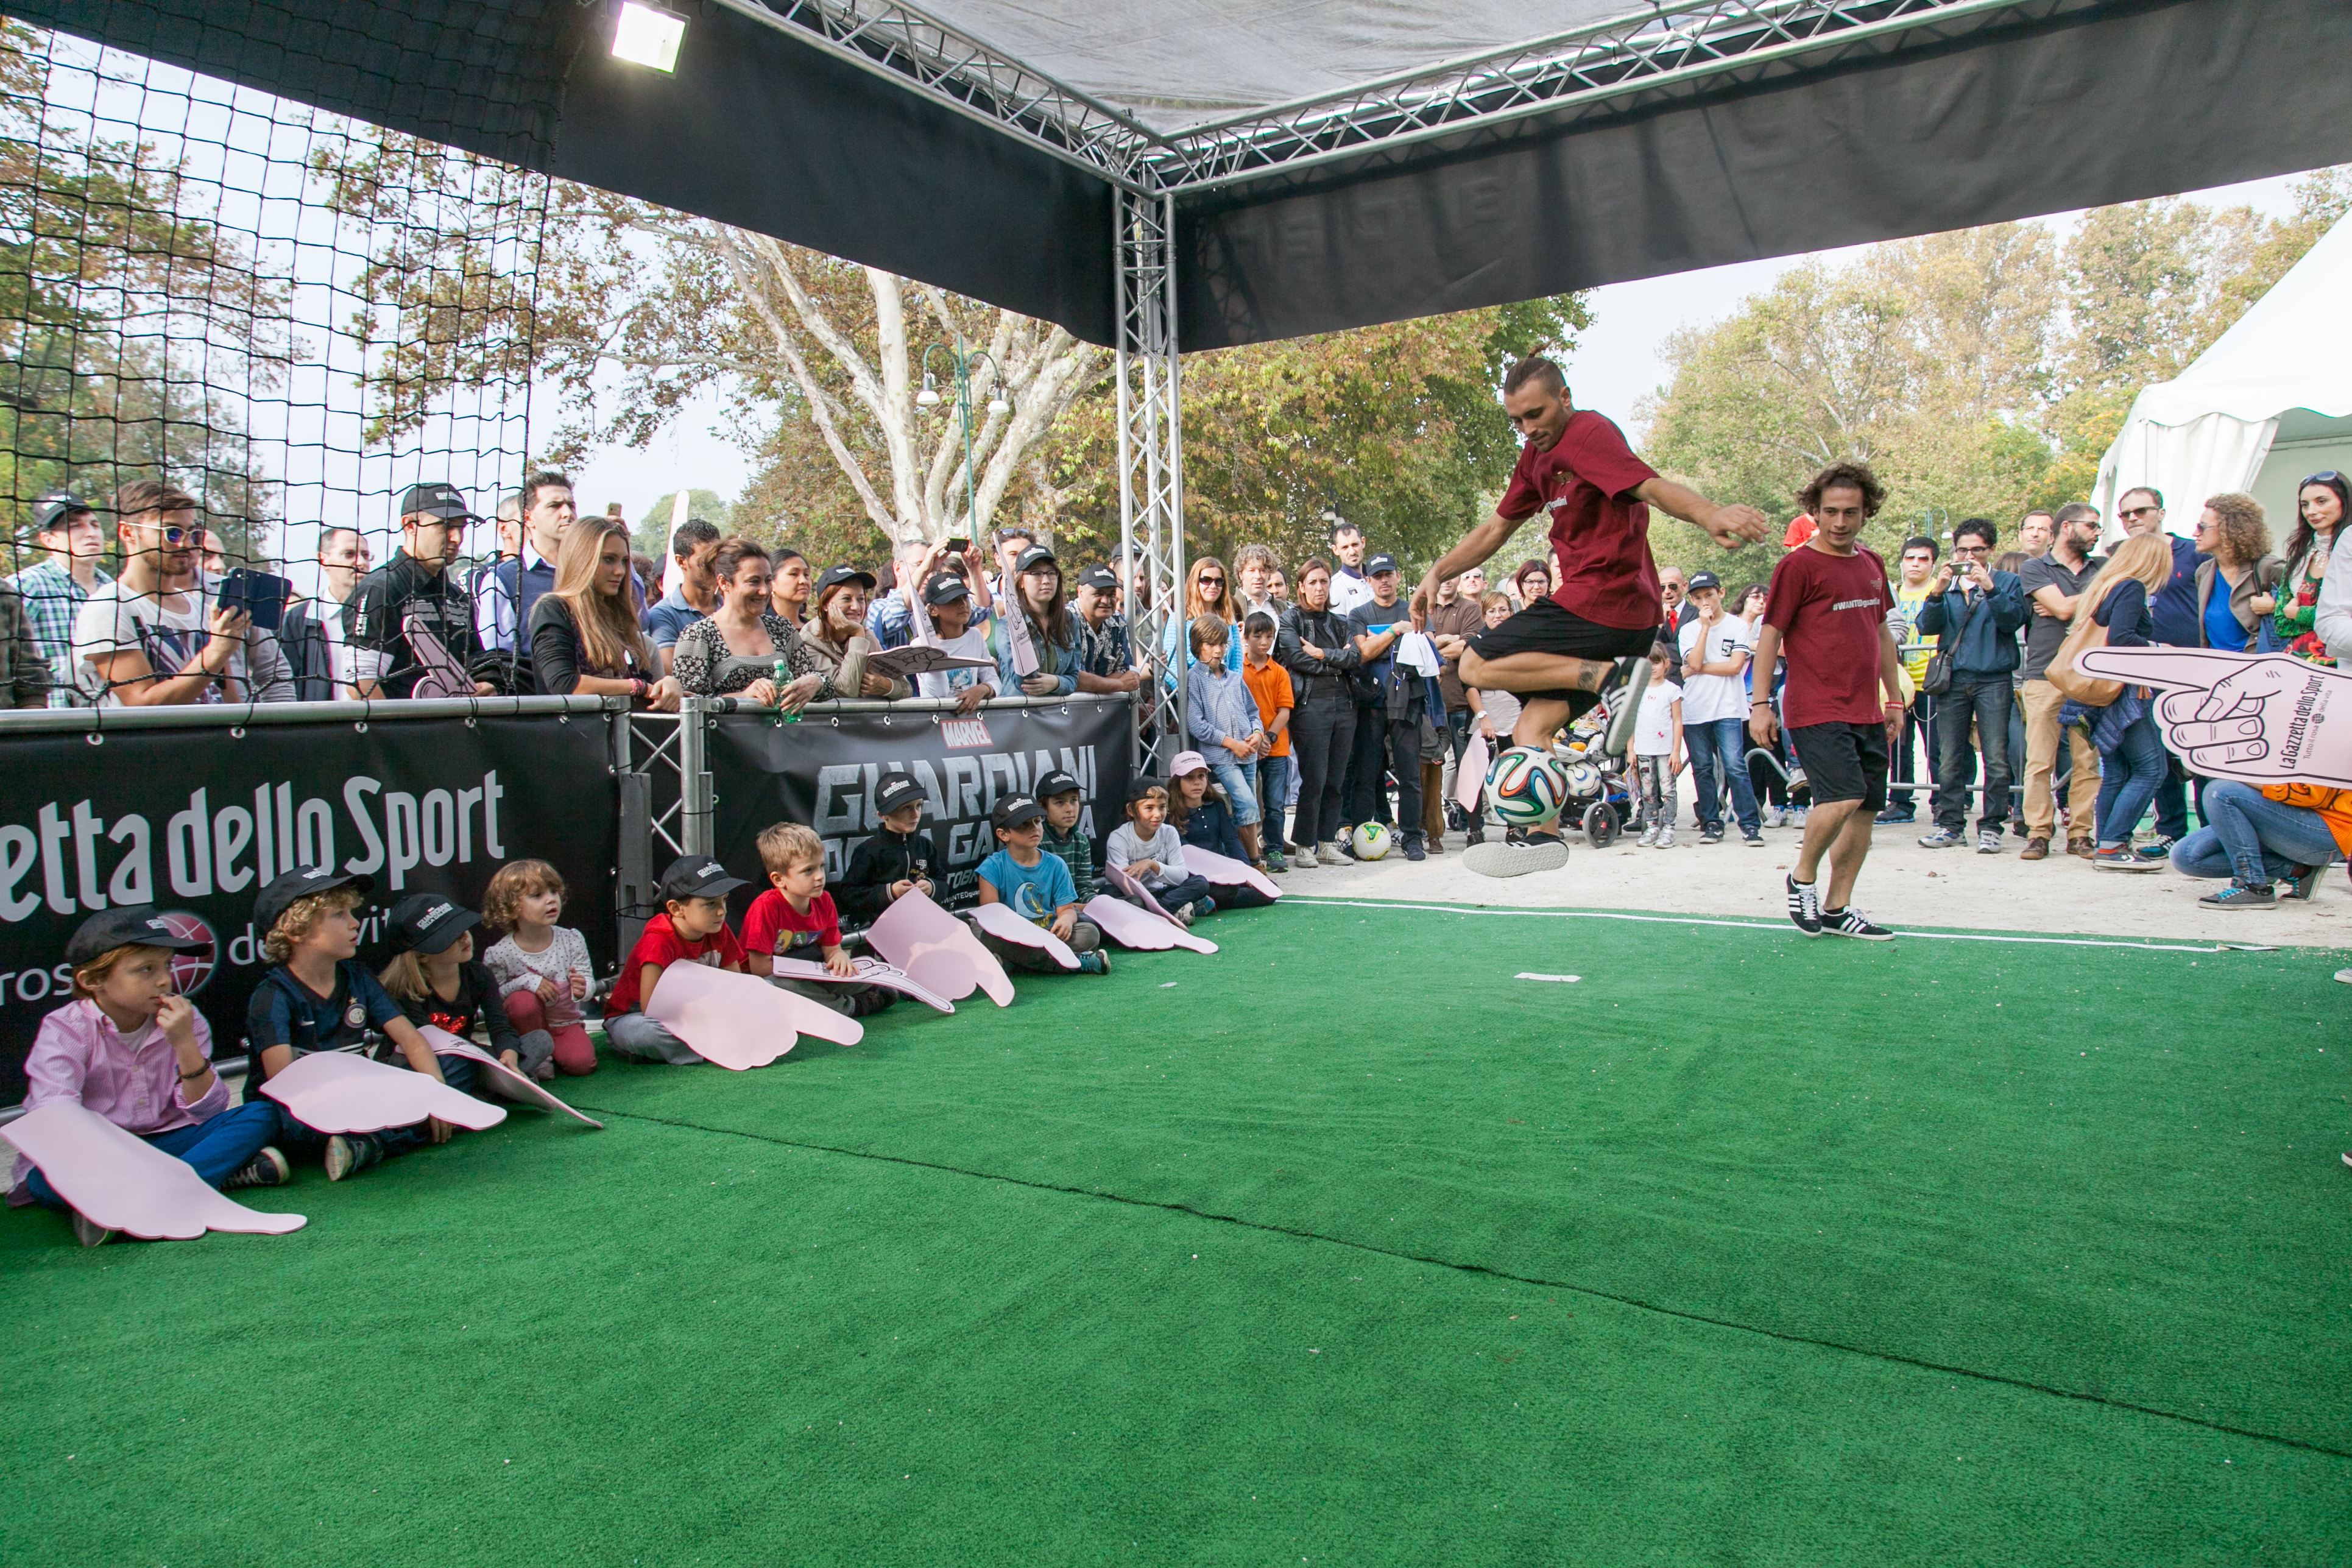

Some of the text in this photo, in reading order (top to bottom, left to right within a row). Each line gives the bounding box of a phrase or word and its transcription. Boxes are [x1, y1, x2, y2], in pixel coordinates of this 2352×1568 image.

[2300, 675, 2325, 696] Sport
[2294, 696, 2315, 716] dello
[942, 721, 992, 747] MARVEL
[2303, 743, 2313, 759] Tutto
[2311, 726, 2319, 738] rosa
[2318, 699, 2328, 712] della
[2324, 690, 2333, 699] vita
[813, 745, 1096, 836] GUARDIANI
[167, 780, 335, 898] dello
[344, 770, 505, 891] Sport
[947, 869, 978, 889] TOBR
[0, 962, 74, 1006] ros
